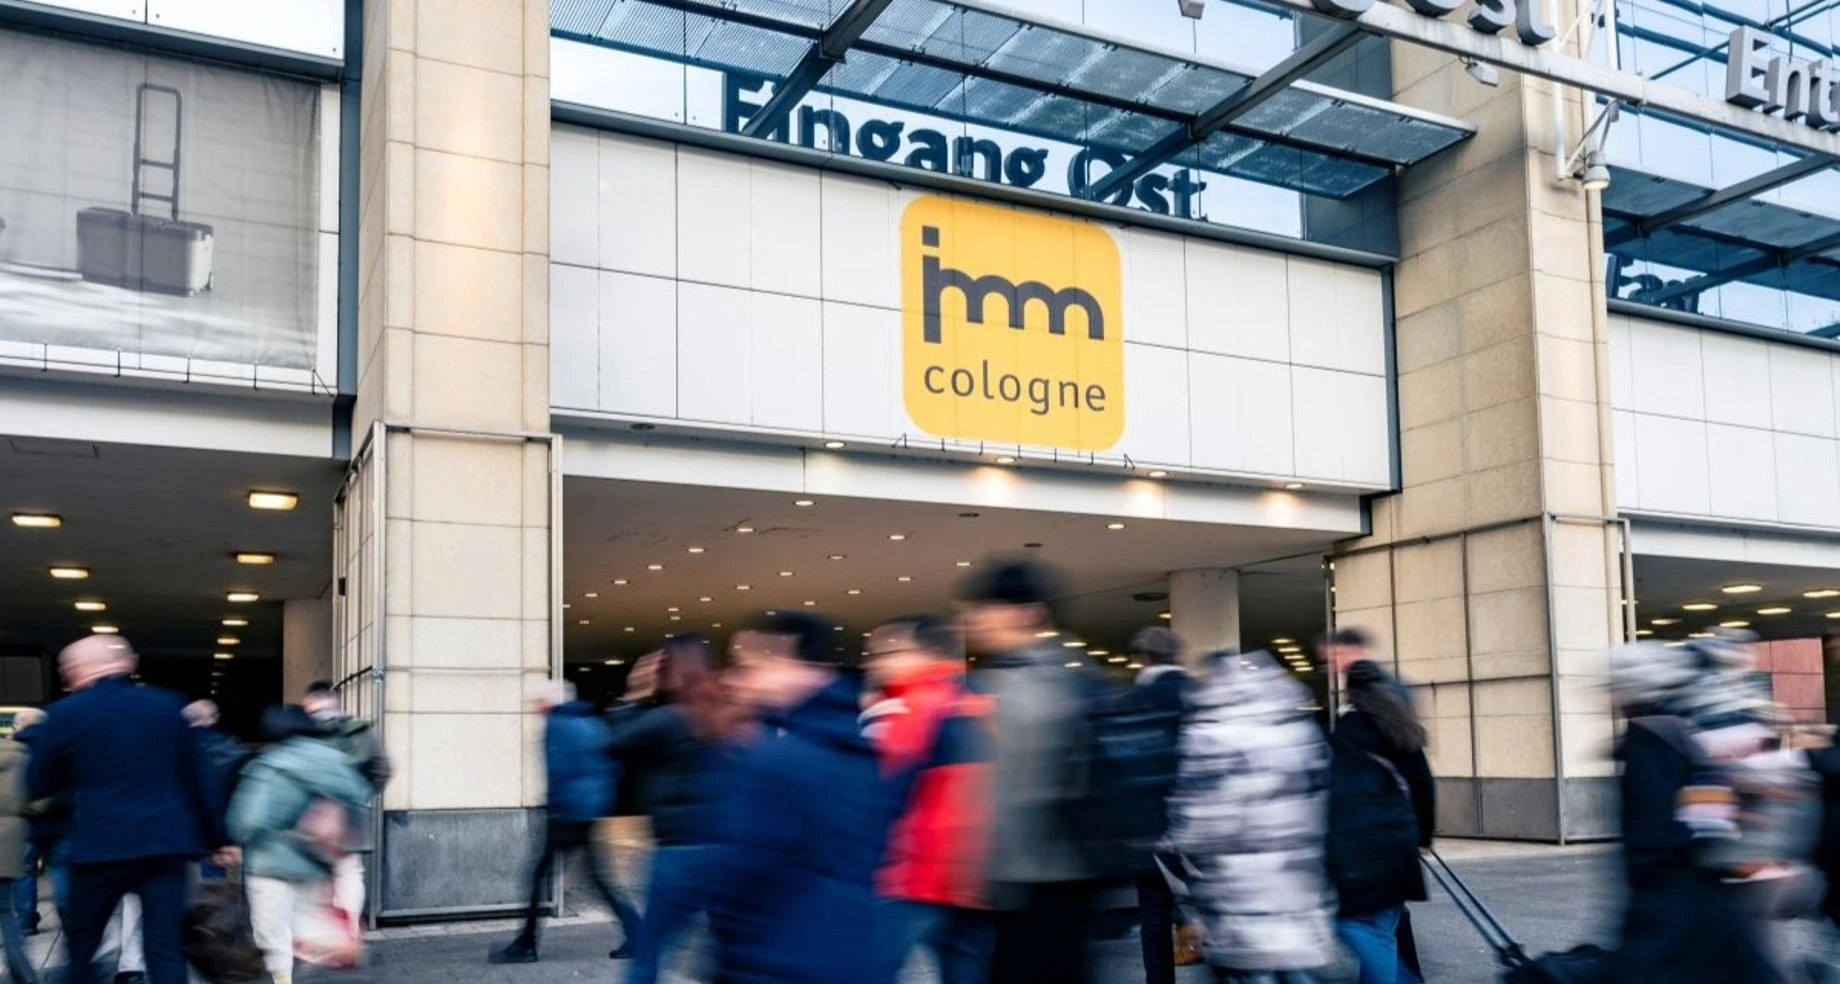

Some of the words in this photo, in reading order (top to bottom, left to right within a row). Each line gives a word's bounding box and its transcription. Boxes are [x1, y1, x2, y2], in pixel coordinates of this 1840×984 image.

[1725, 25, 1840, 134] Ent
[921, 225, 1105, 344] imm
[924, 359, 1106, 416] cologne
